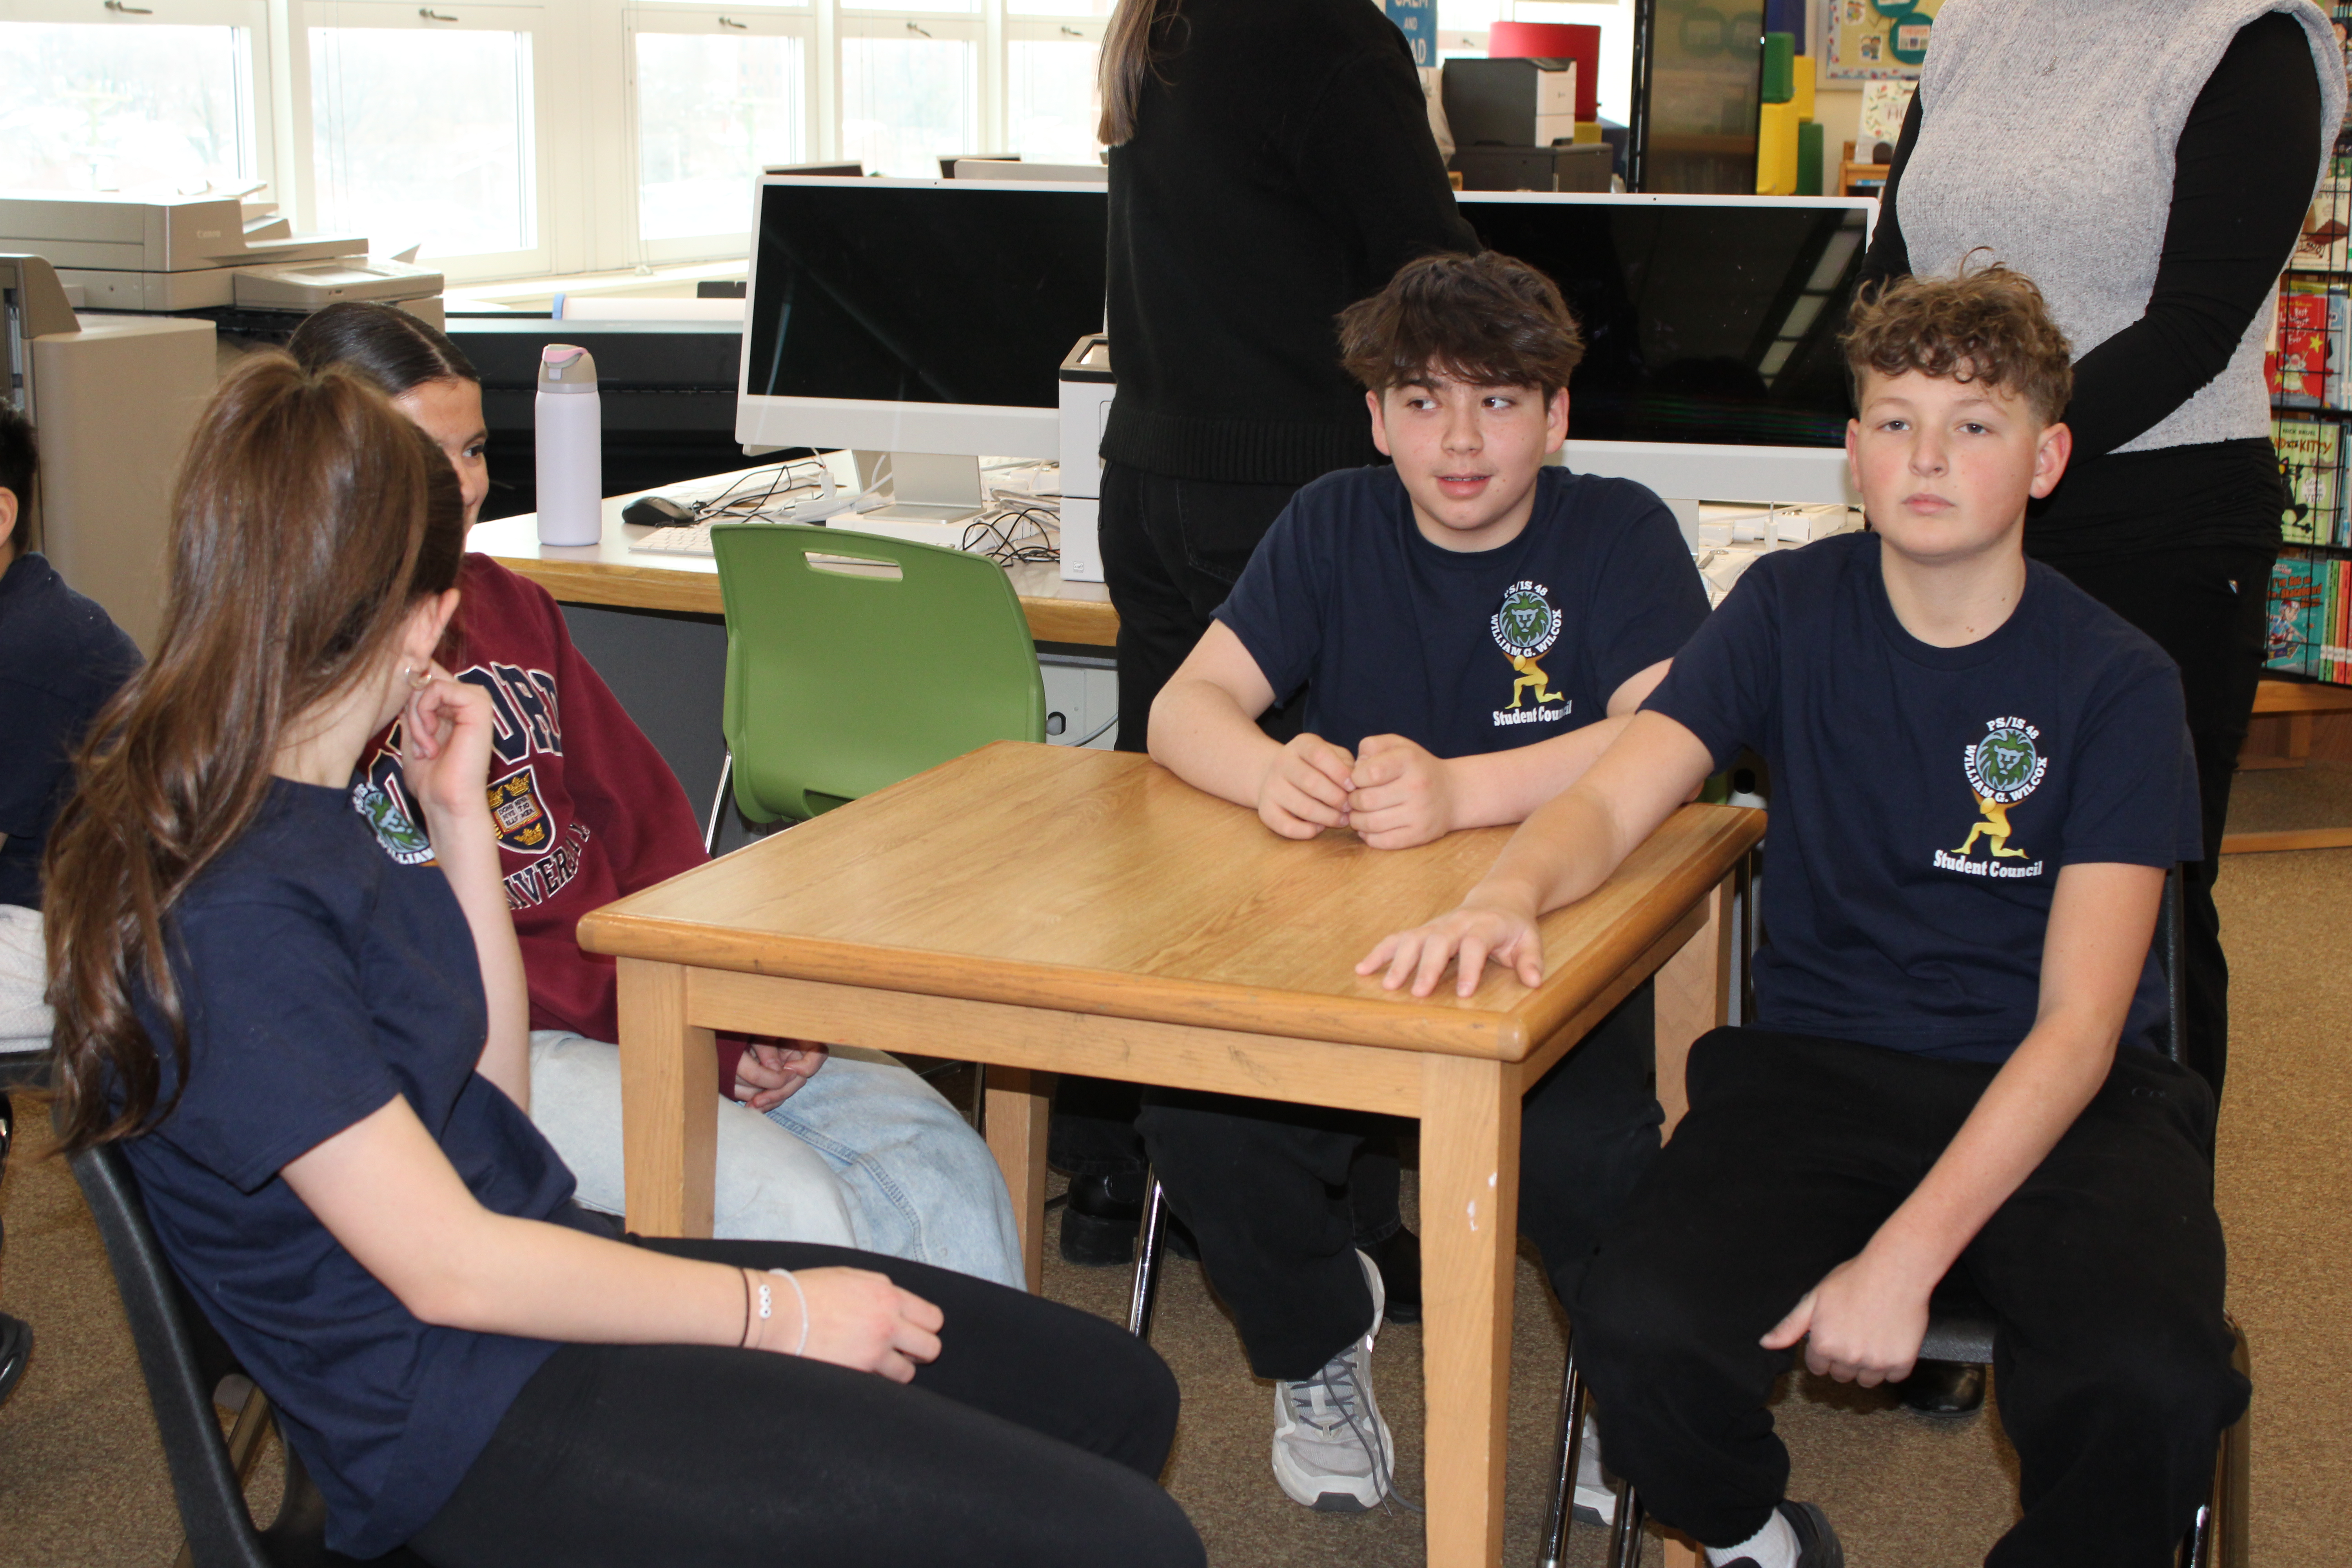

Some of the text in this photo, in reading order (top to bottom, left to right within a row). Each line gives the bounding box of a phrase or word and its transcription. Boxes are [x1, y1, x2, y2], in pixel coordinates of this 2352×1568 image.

[197, 230, 221, 239] Canon
[1534, 584, 1548, 596] 48
[1490, 609, 1562, 657] WILLIAM G. WILCOX
[1493, 707, 1537, 726] Student
[1986, 716, 2040, 740] PS/IS 48
[1964, 744, 2048, 803] WILLIAM G. WILCOX
[1933, 849, 2043, 878] Student Council
